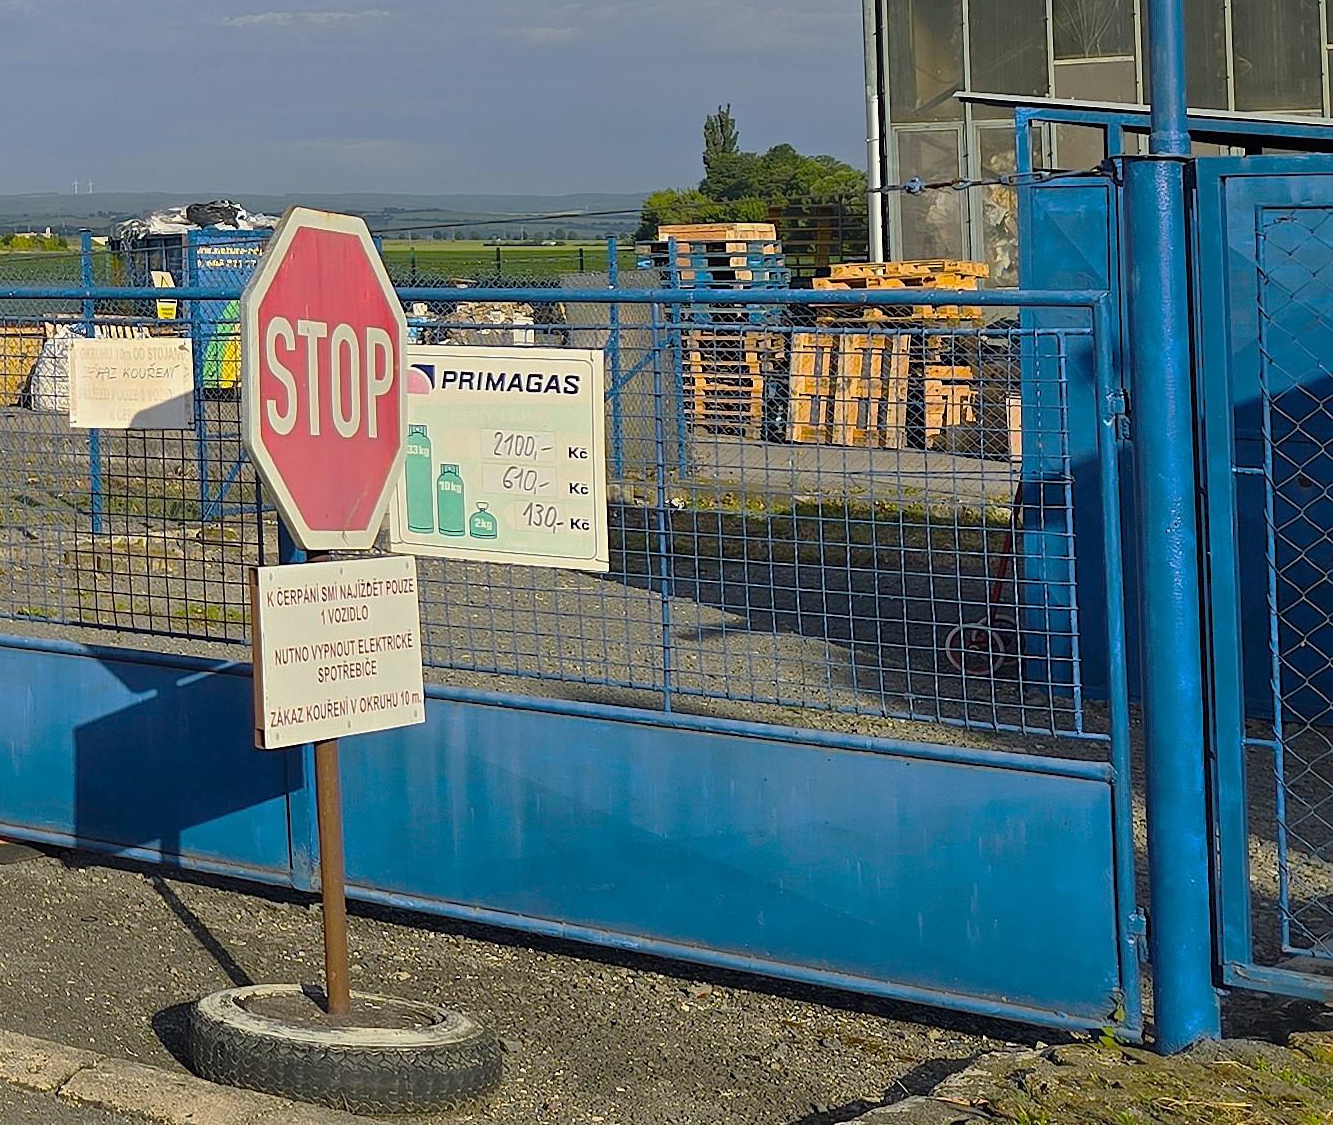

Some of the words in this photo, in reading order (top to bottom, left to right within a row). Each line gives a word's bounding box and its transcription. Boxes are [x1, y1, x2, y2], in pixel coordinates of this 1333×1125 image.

[133, 346, 145, 361] OD
[266, 316, 394, 438] STOP
[442, 370, 580, 394] PRIMAGAS
[568, 447, 588, 459] Kč
[569, 483, 589, 495] Kč
[570, 518, 590, 531] Kč
[267, 591, 275, 607] K
[276, 583, 320, 607] ČERPÁNÍ
[321, 582, 338, 602] SMÍ
[339, 578, 384, 601] NAJÍŽDĚT
[386, 578, 414, 595] POUZE
[321, 611, 326, 625] 1
[328, 605, 369, 624] VOZIDLO
[275, 646, 309, 665] NUTNO
[311, 640, 356, 660] VYPNOUT
[358, 630, 414, 654] ELEKTRICKÉ
[318, 657, 377, 683] SPOTŘEBIČE
[271, 707, 304, 727] ZÁKAZ
[306, 697, 349, 720] KOUŘENÍ
[350, 699, 358, 714] V
[360, 693, 399, 713] OKRUHU
[400, 691, 410, 705] 10
[412, 692, 421, 704] m.
